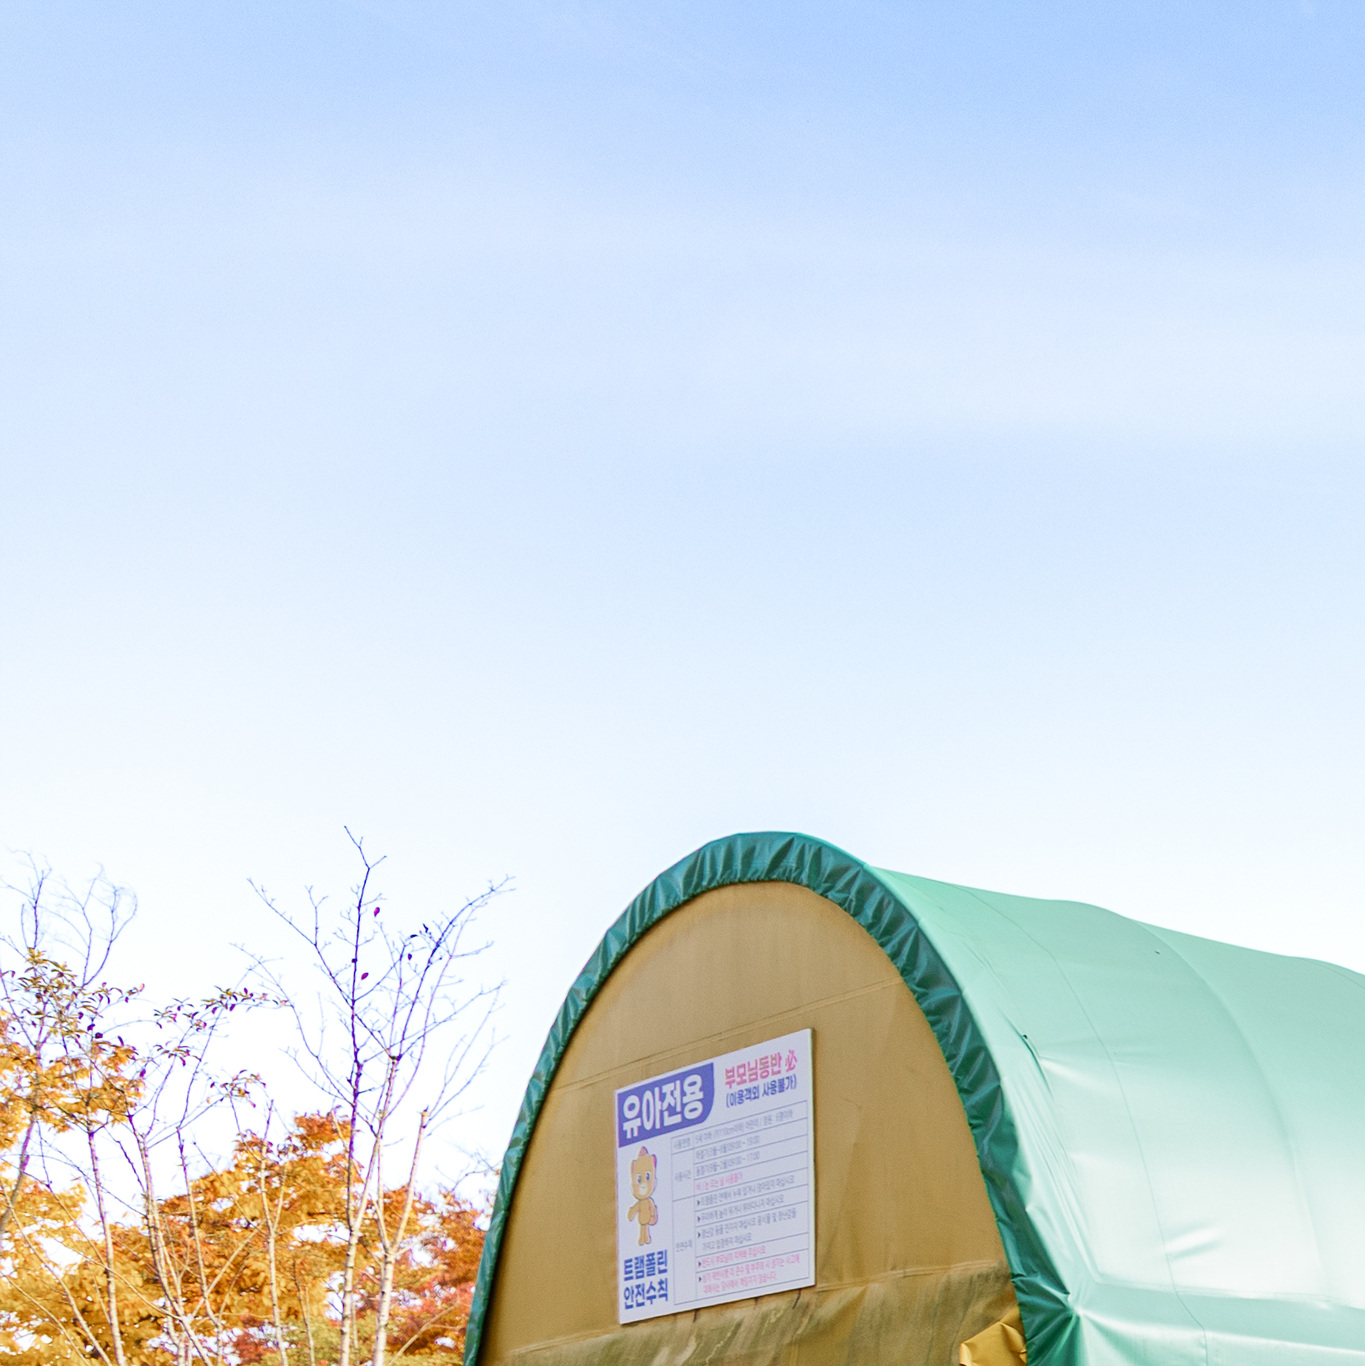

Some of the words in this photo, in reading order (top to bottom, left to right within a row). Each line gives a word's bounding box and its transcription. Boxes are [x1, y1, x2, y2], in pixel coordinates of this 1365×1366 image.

[725, 1052, 782, 1089] 부모님동반
[623, 1074, 704, 1139] 유아전용
[624, 1249, 668, 1281] 트램폴린
[624, 1277, 668, 1310] 안전수칙
